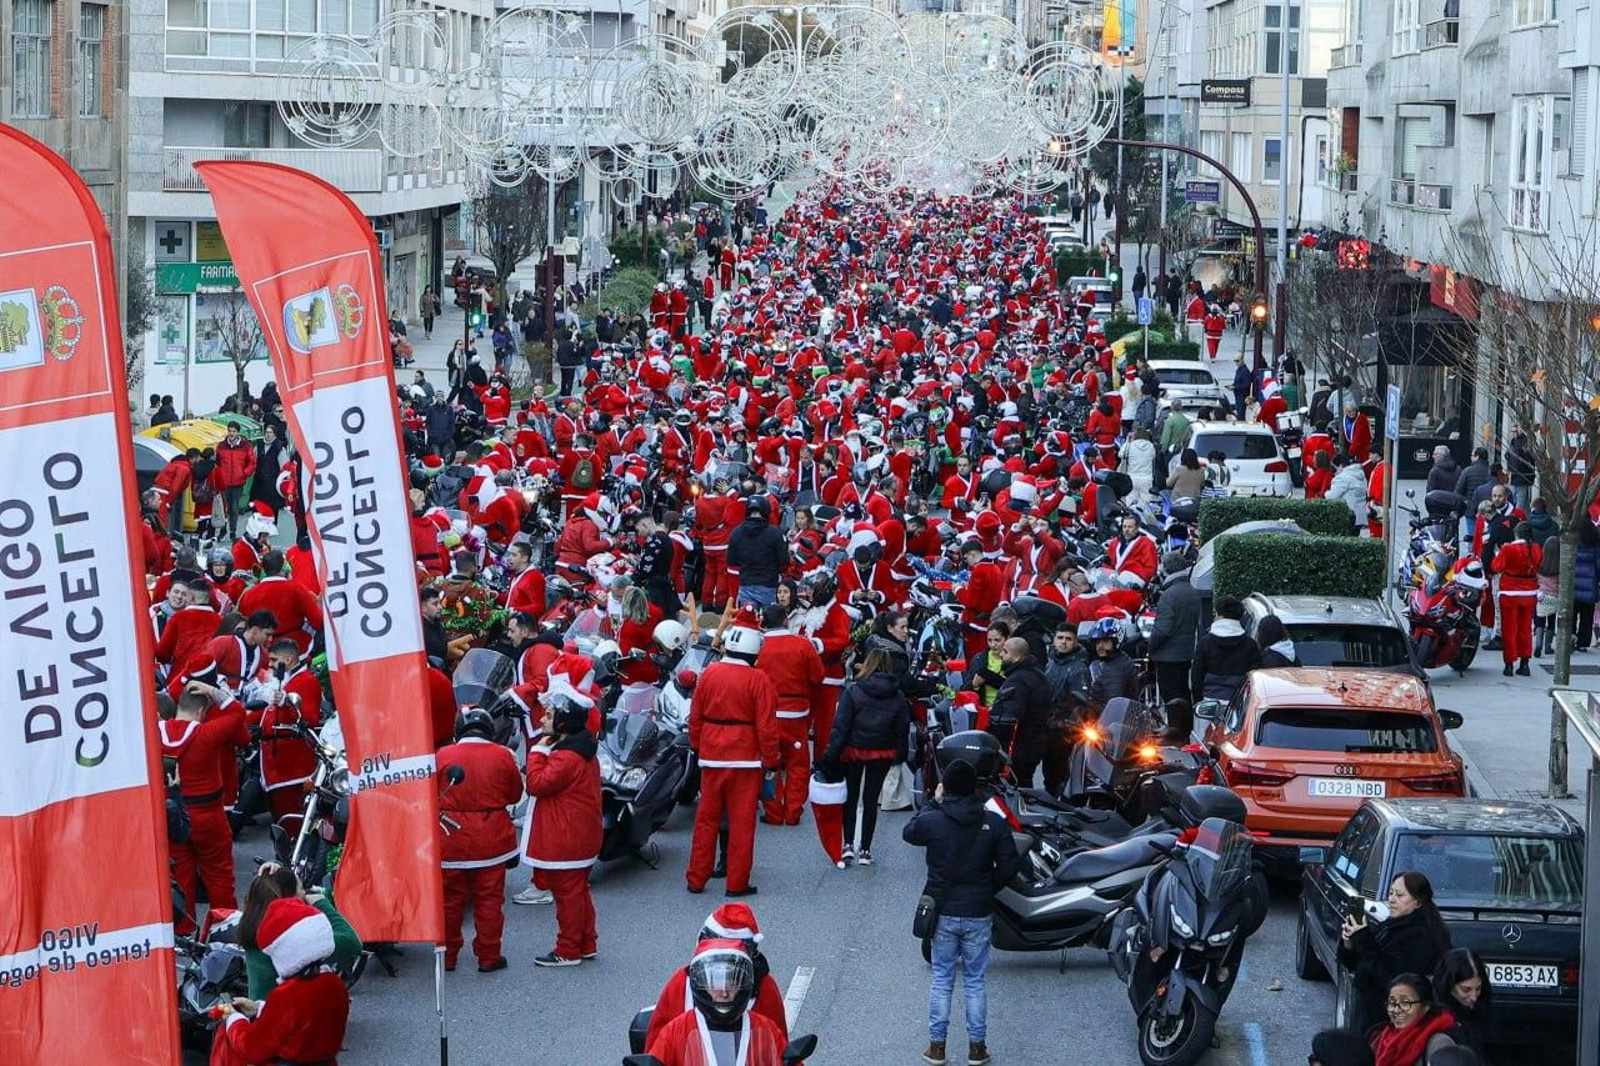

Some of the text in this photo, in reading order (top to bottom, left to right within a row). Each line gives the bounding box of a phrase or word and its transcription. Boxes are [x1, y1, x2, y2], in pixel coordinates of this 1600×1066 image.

[1205, 85, 1245, 94] Compass
[1318, 781, 1382, 796] 0328 NBD
[1494, 966, 1533, 982] 6853
[1537, 967, 1556, 984] AX
